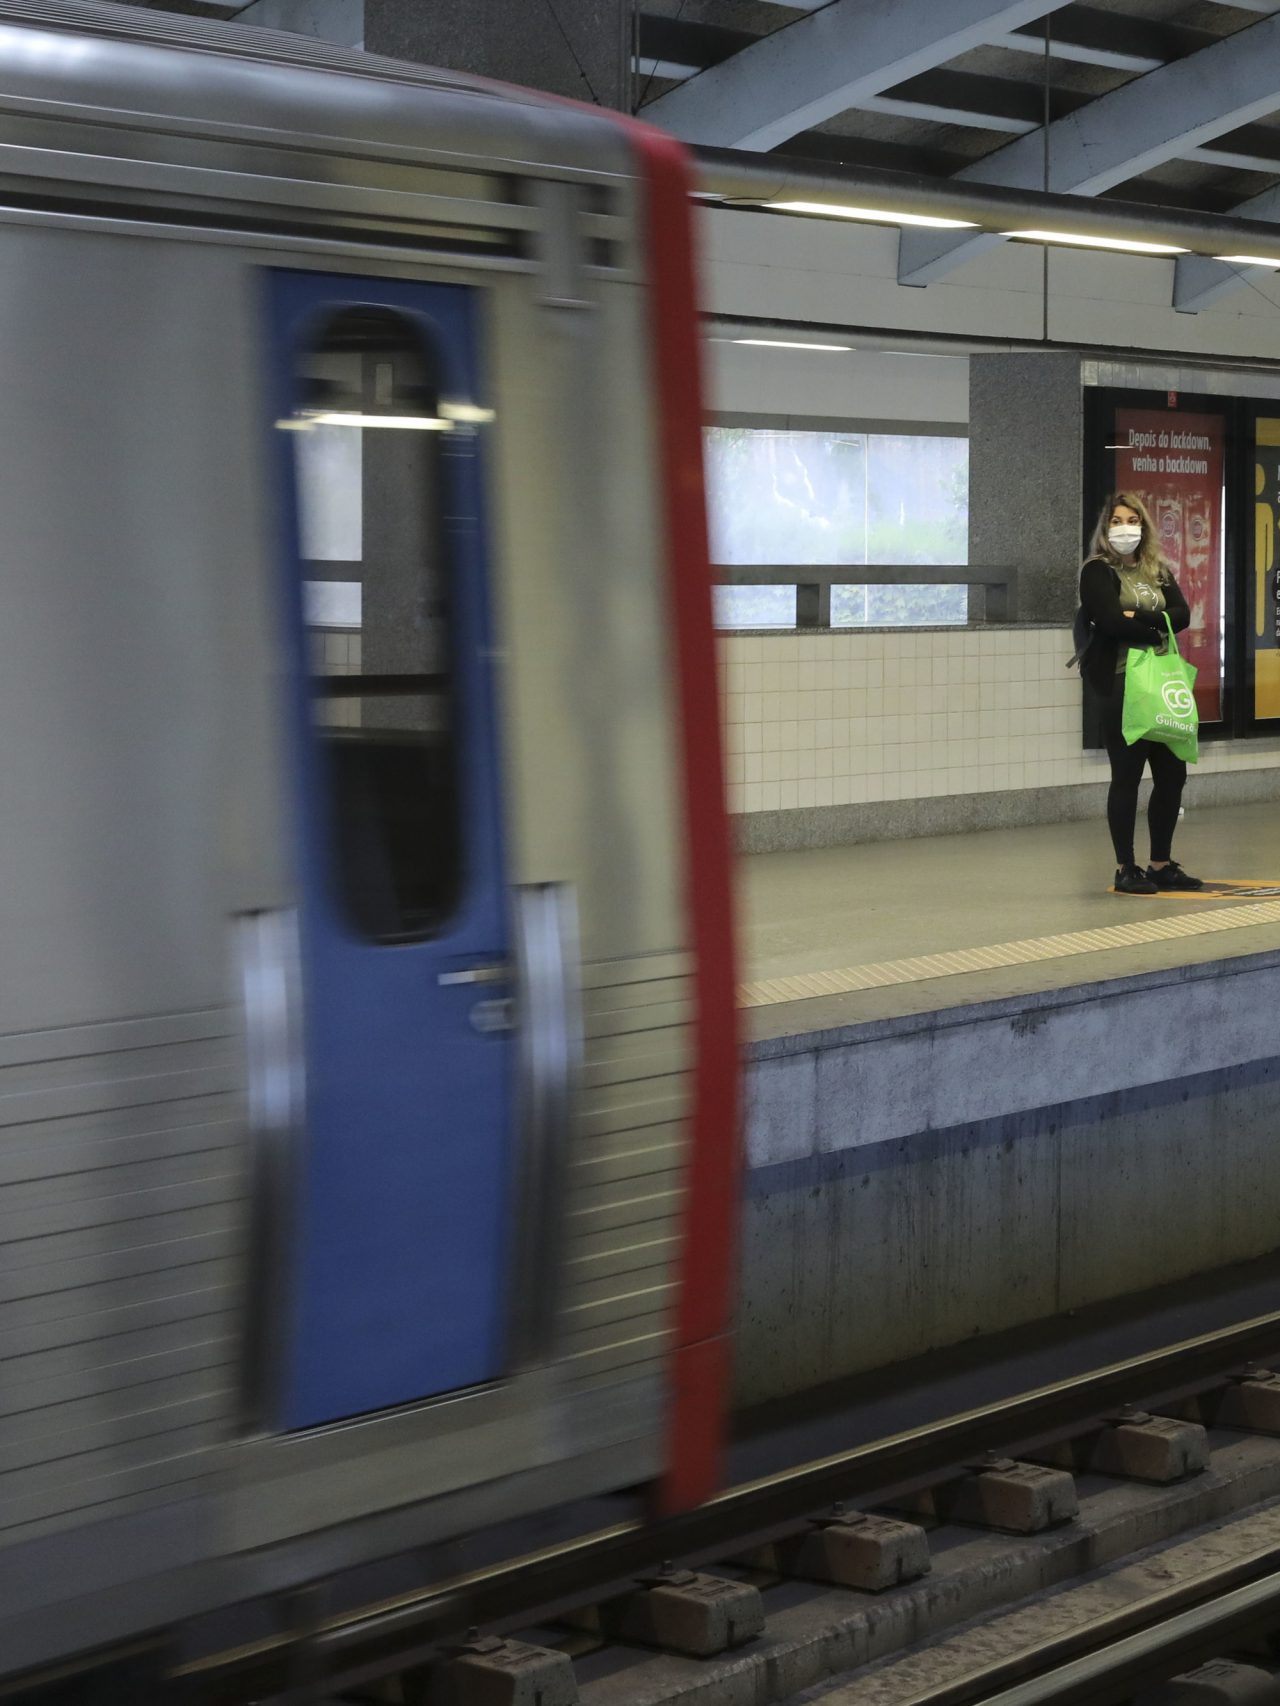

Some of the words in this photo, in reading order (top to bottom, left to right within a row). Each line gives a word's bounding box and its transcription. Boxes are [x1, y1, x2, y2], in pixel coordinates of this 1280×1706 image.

[1128, 429, 1157, 452] Depois
[1158, 430, 1169, 448] do
[1170, 430, 1212, 451] lockdown,
[1132, 454, 1157, 472] venha
[1159, 458, 1165, 473] o
[1166, 455, 1208, 474] bockdown
[1165, 688, 1192, 709] CG
